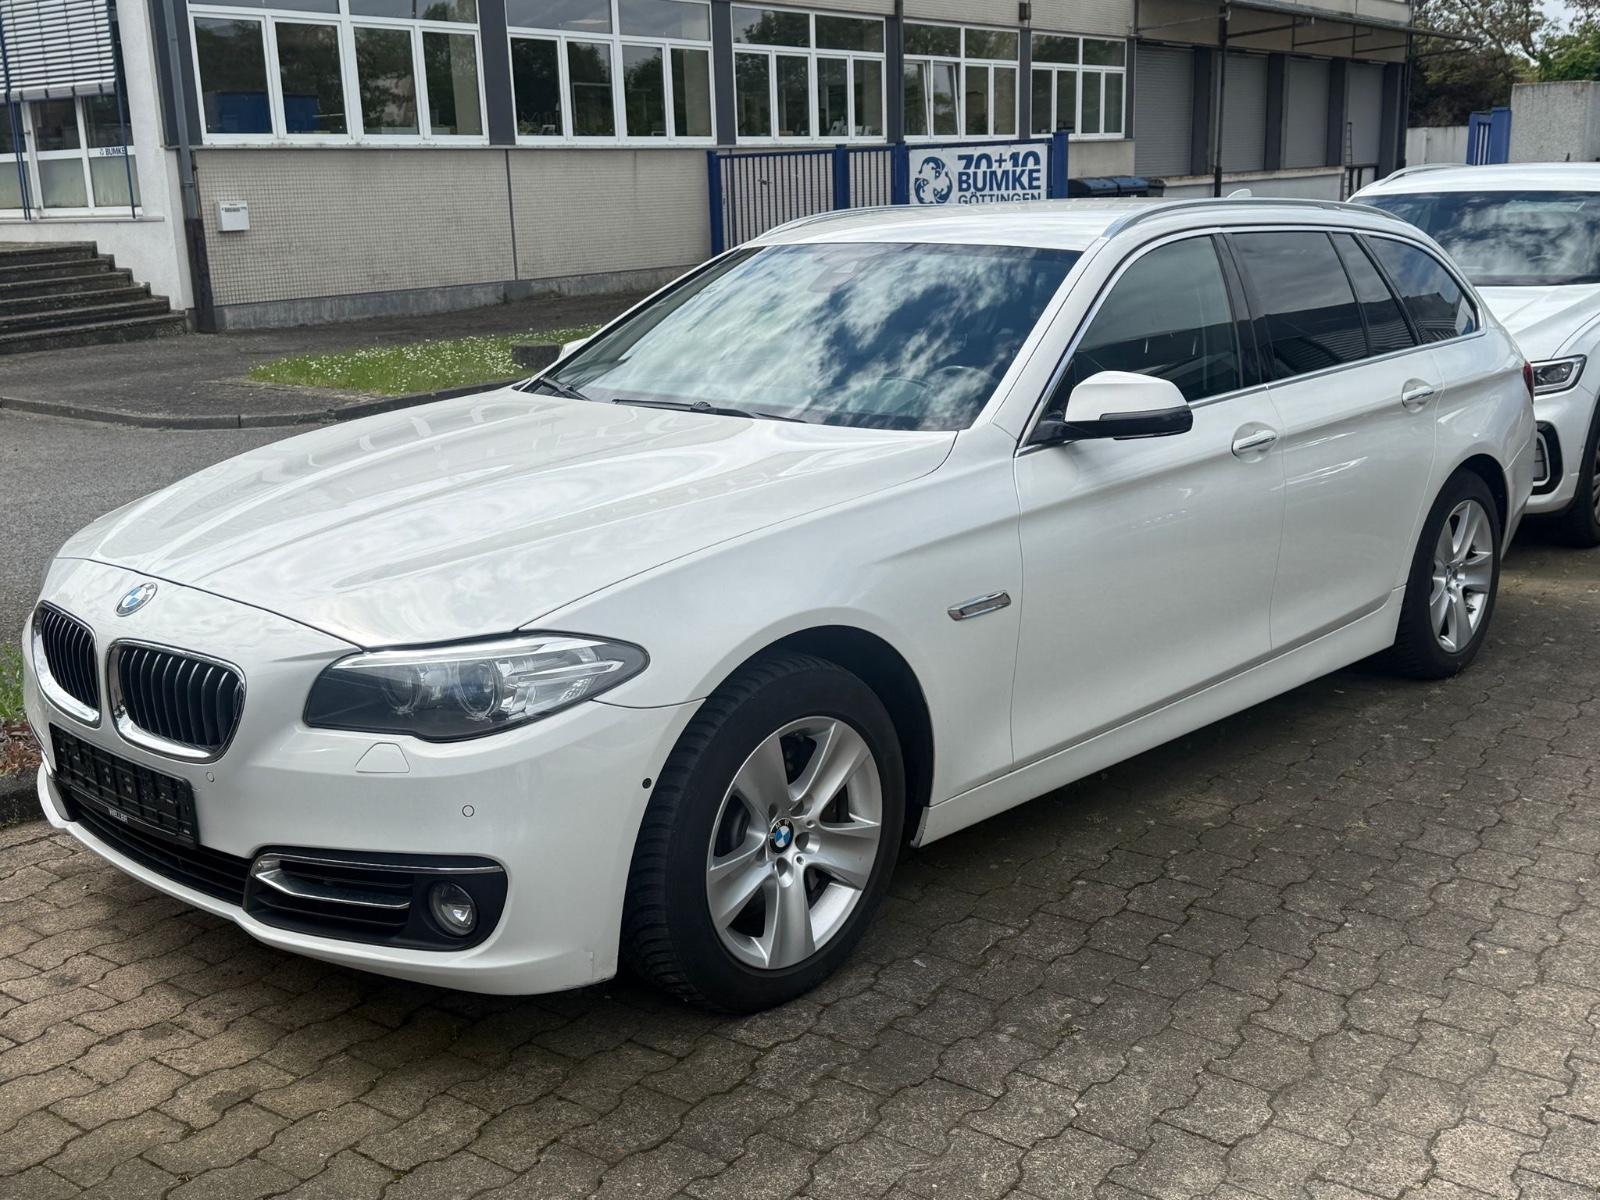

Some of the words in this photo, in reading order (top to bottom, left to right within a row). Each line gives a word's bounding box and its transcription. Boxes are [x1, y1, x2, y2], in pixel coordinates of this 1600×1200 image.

[957, 150, 1041, 170] 70+10
[957, 168, 1041, 193] BUMKE
[958, 191, 1041, 204] GÖTTINGEN
